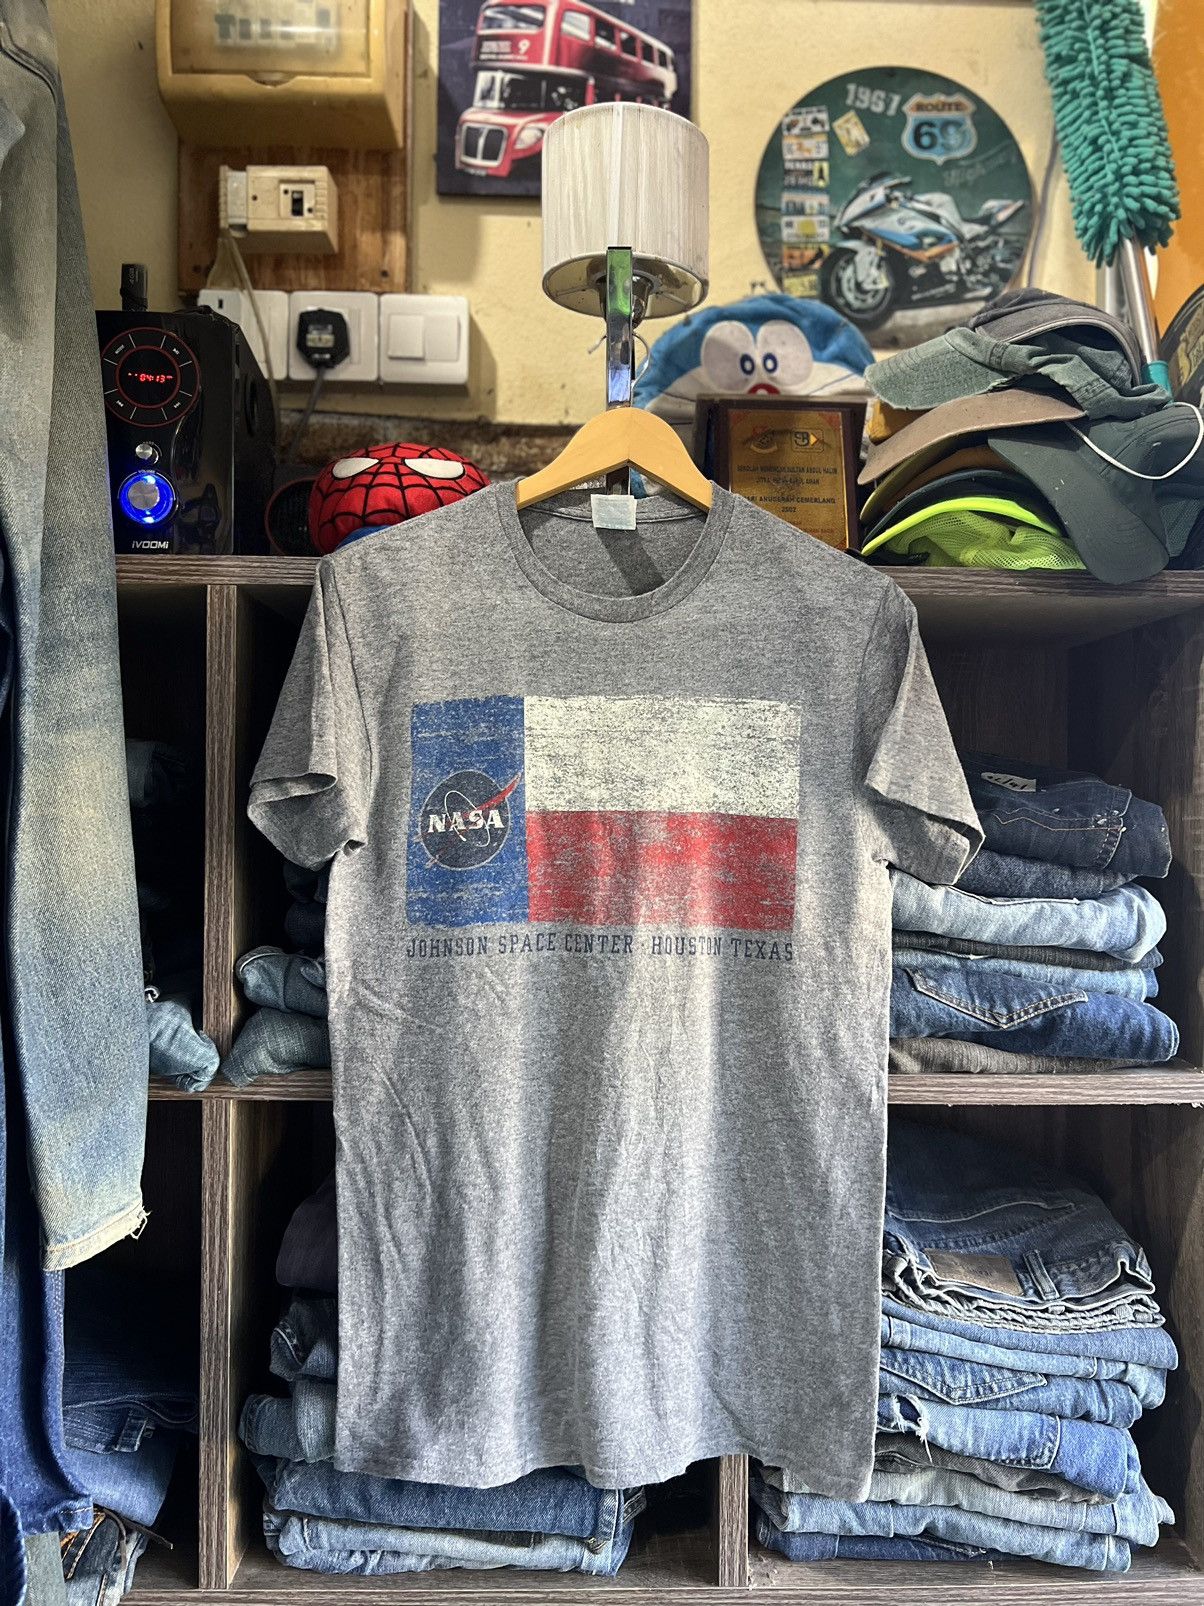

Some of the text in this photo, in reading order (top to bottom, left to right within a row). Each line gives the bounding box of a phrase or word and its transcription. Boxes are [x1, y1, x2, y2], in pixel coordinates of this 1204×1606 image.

[517, 39, 531, 55] 9
[845, 83, 902, 117] 1967
[915, 100, 964, 112] ROUTE
[140, 373, 166, 383] 04:13
[427, 809, 506, 833] NASA
[407, 932, 794, 962] JOHNSON SPACE CENTER HOUSTON TEXAS
